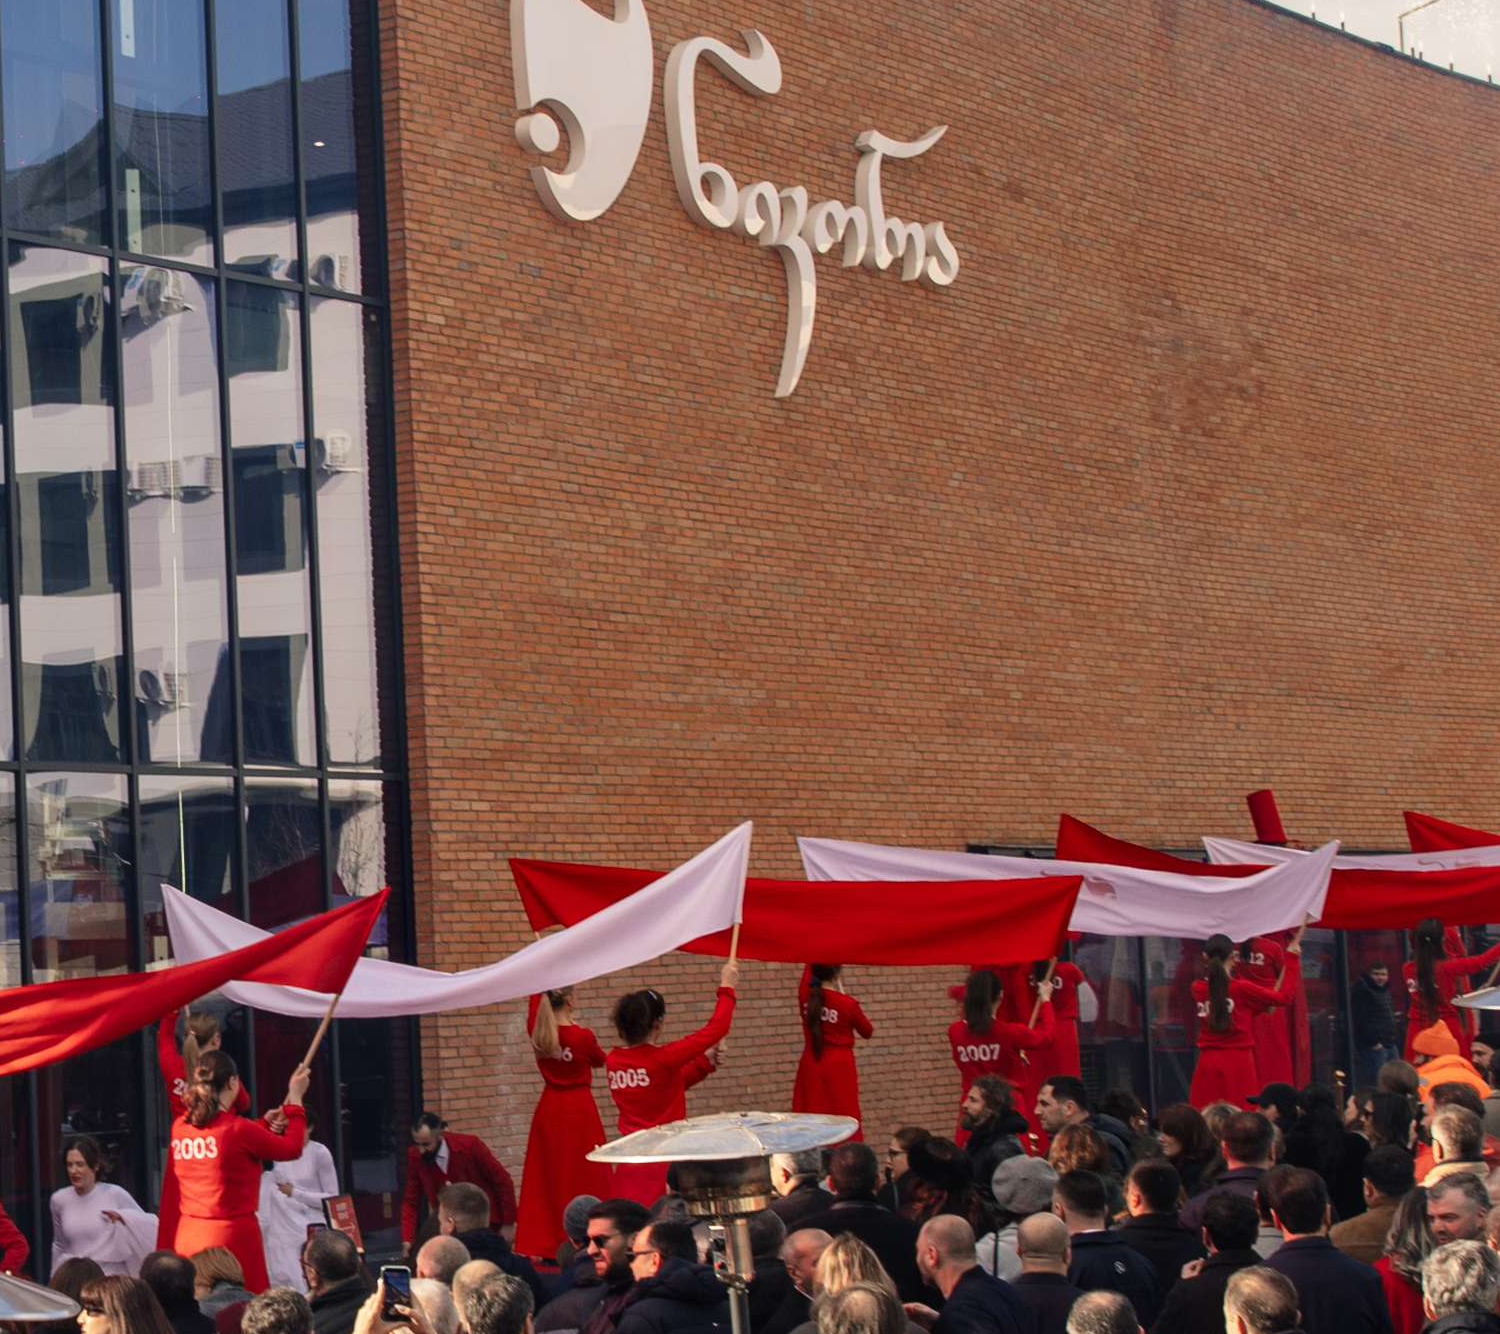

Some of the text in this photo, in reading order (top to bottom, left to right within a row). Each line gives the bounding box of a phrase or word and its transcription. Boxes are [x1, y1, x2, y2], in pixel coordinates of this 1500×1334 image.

[1232, 950, 1265, 966] 212
[957, 1043, 1001, 1063] 2007
[608, 1067, 651, 1090] 2005
[170, 1135, 219, 1161] 2003
